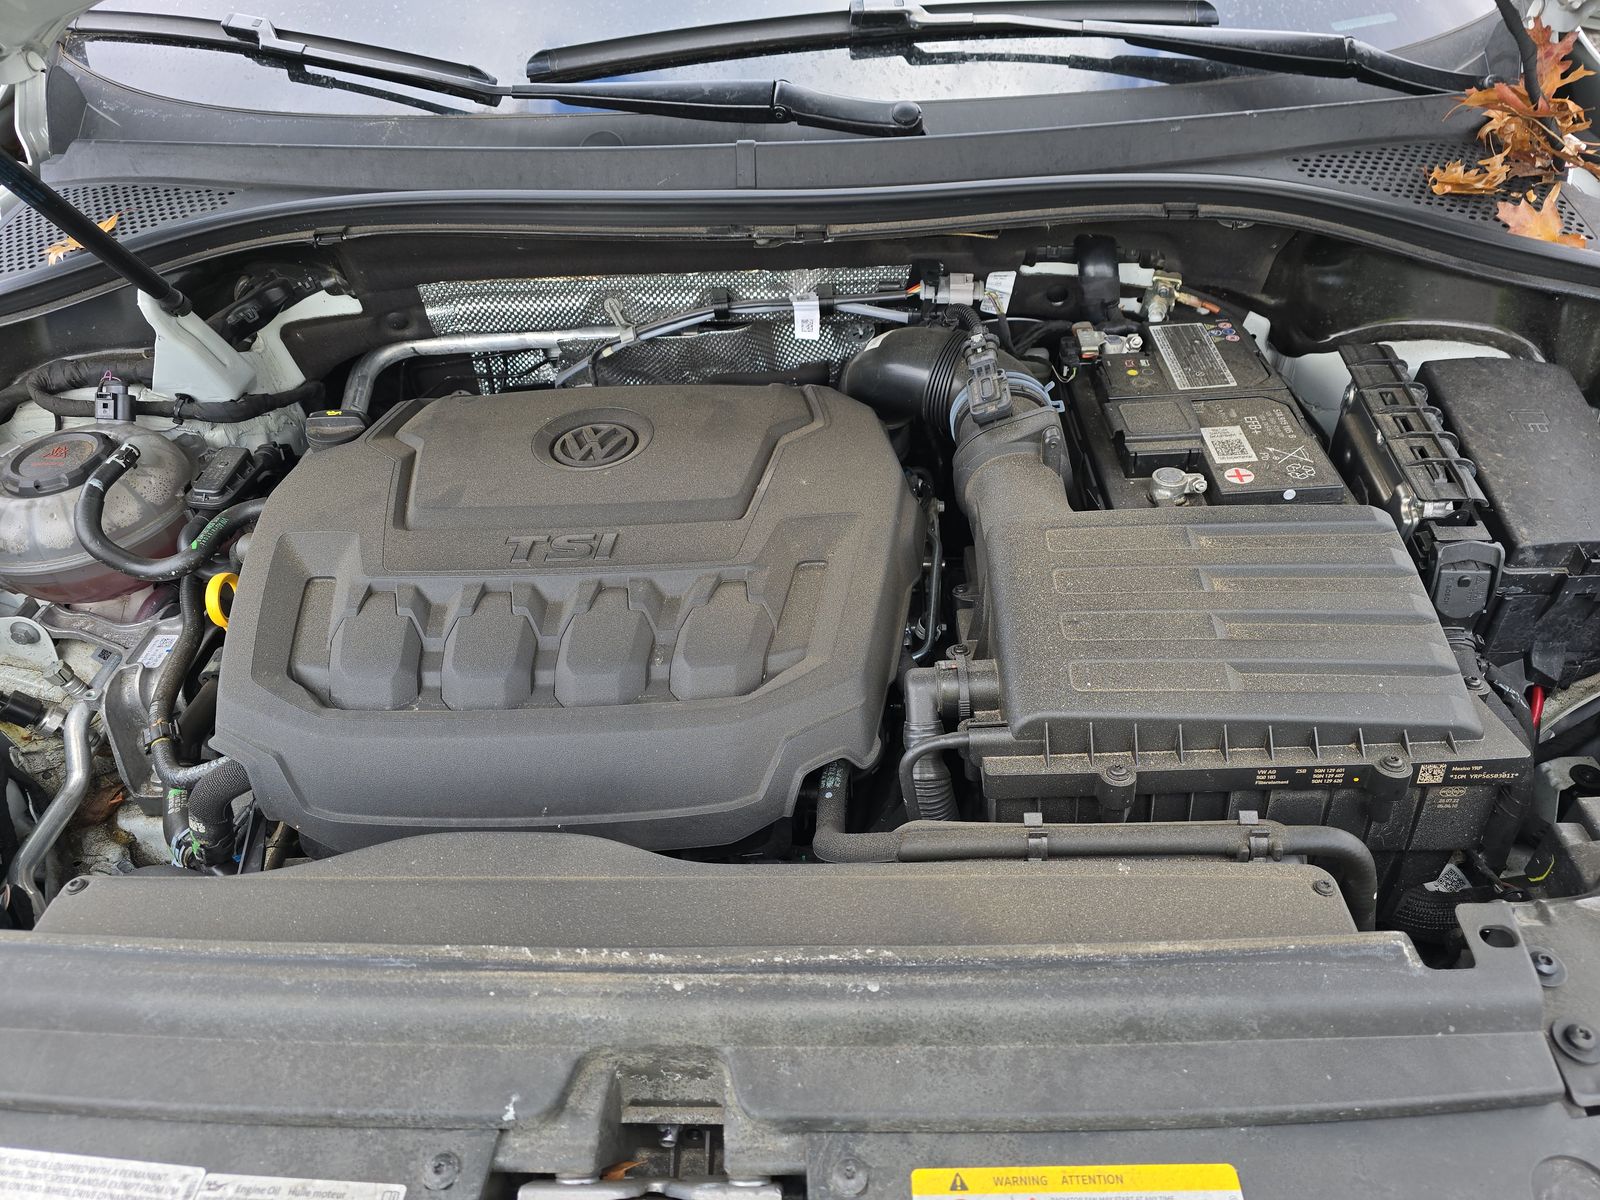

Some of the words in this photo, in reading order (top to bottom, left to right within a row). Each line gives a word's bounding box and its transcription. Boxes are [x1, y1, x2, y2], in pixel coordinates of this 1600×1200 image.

[1244, 416, 1262, 434] EFB+
[553, 422, 637, 468] VW
[504, 532, 620, 563] TSI
[993, 1175, 1048, 1186] WARNING
[1061, 1174, 1124, 1185] ATTENTION
[235, 1184, 266, 1196] Engine
[267, 1185, 282, 1195] Oil
[288, 1186, 311, 1197] Huile
[313, 1189, 346, 1199] moteur
